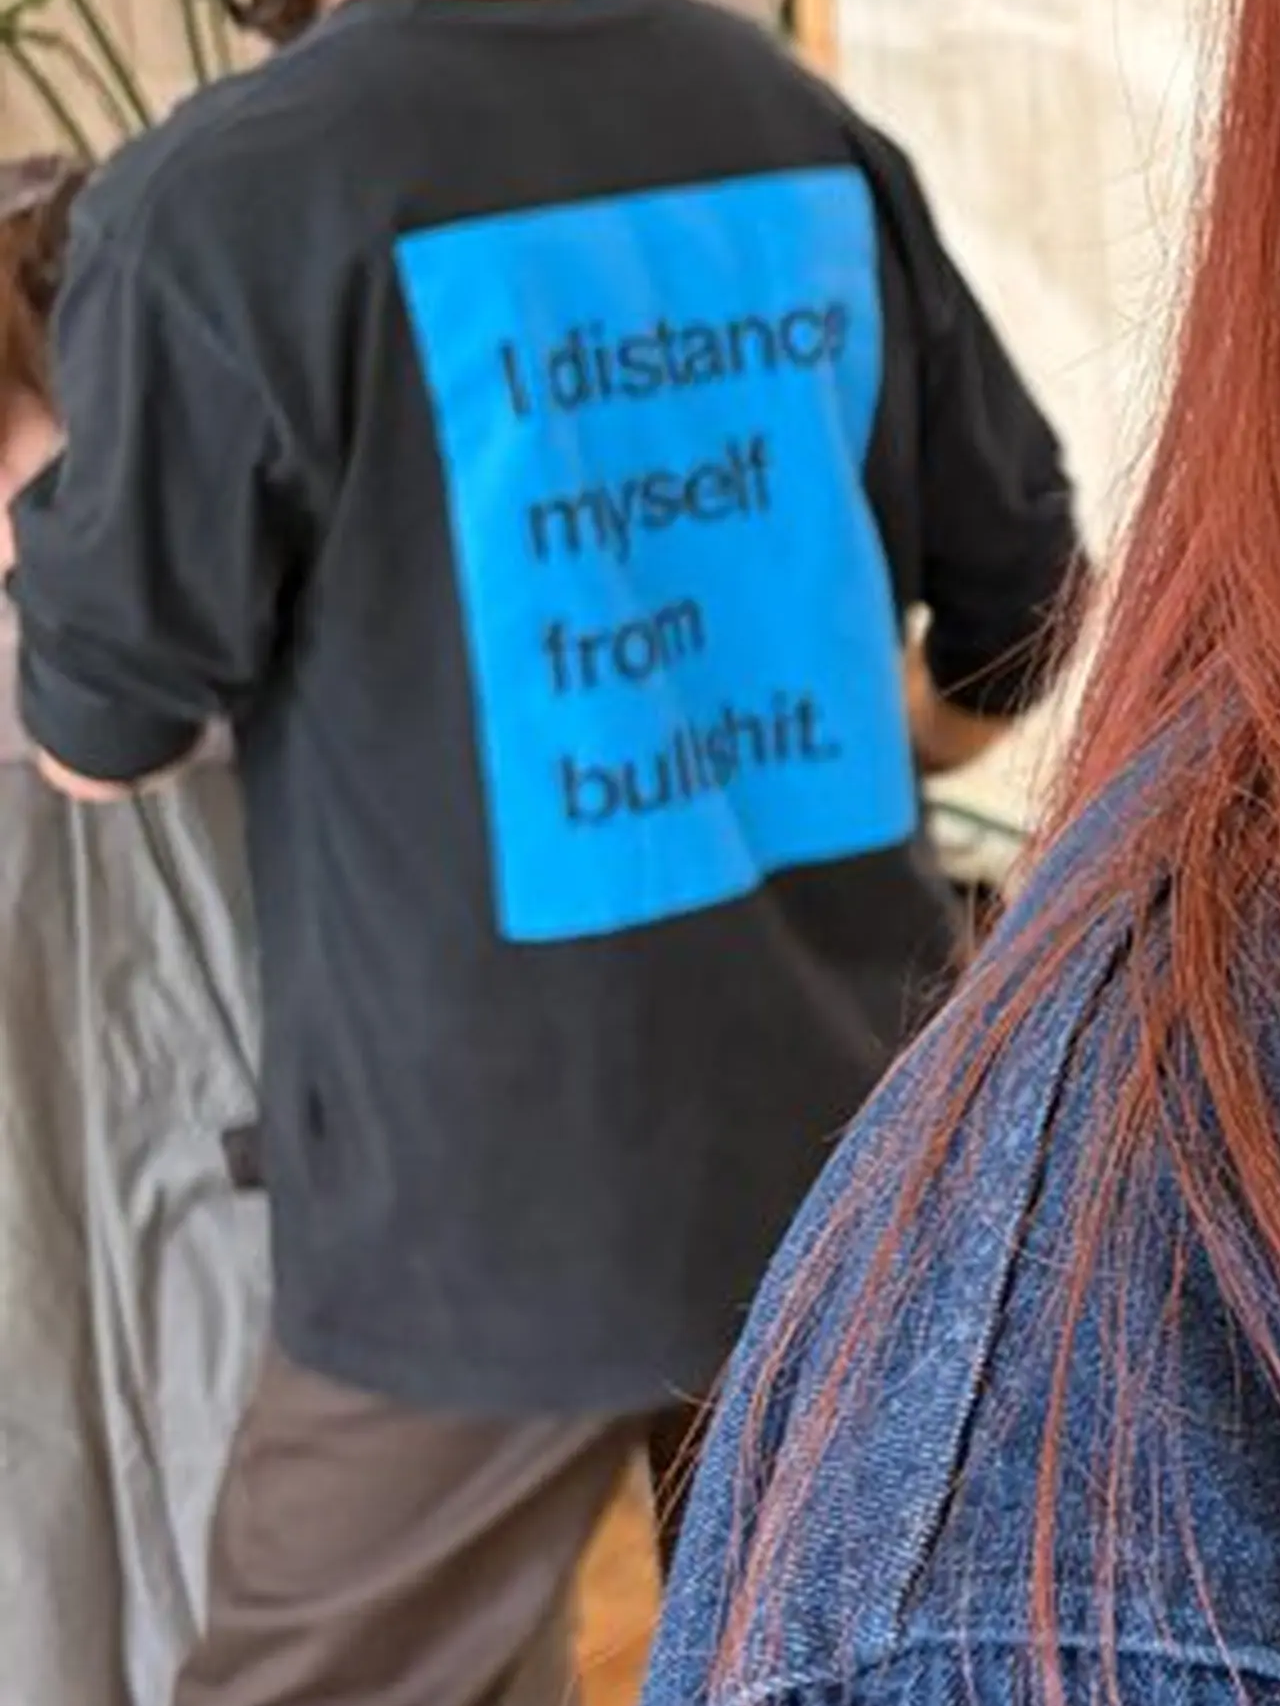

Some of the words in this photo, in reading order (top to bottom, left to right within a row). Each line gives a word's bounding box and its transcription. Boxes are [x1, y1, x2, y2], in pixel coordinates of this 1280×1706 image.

[499, 339, 530, 418] I
[529, 431, 771, 562] myself
[544, 599, 706, 692] from
[560, 691, 841, 824] bullshit.
